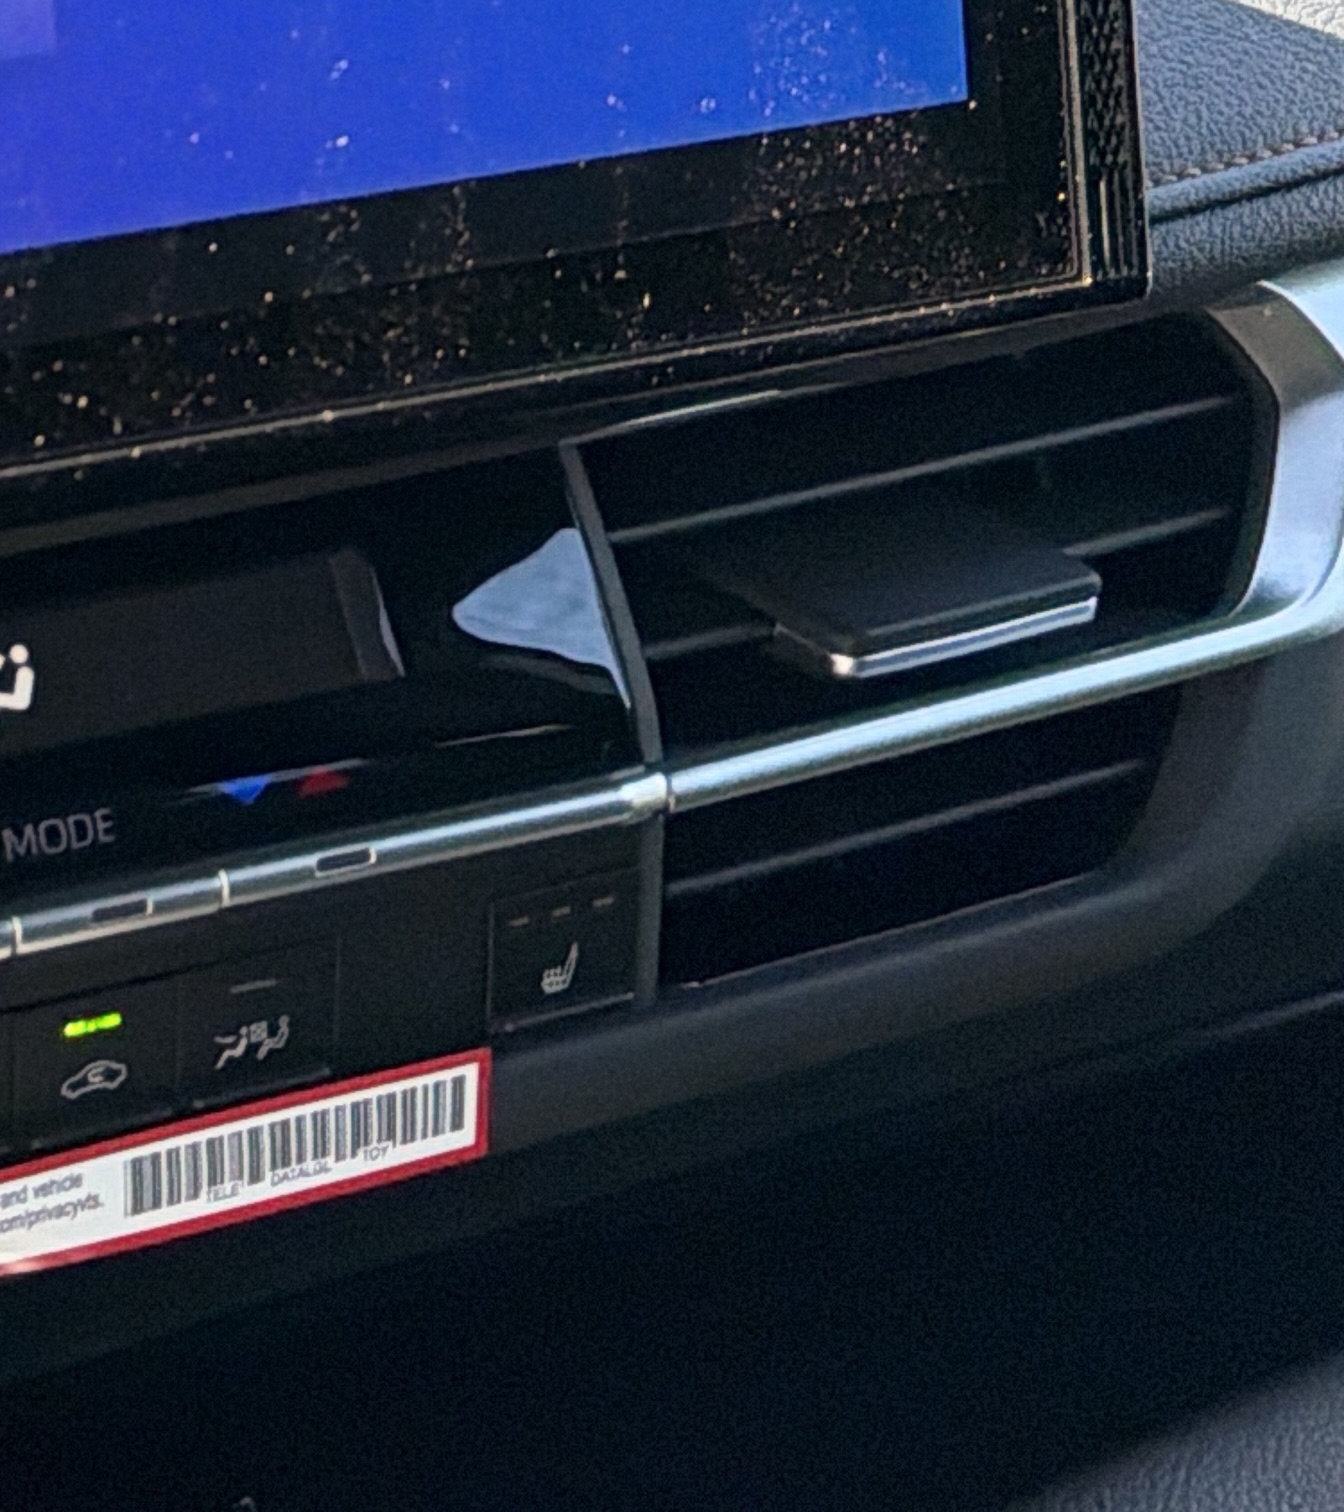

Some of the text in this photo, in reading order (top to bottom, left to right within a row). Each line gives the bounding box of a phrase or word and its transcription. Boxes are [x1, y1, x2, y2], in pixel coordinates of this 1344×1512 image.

[1, 807, 116, 863] MODE
[0, 1184, 29, 1209] and
[31, 1172, 84, 1198] vehicle
